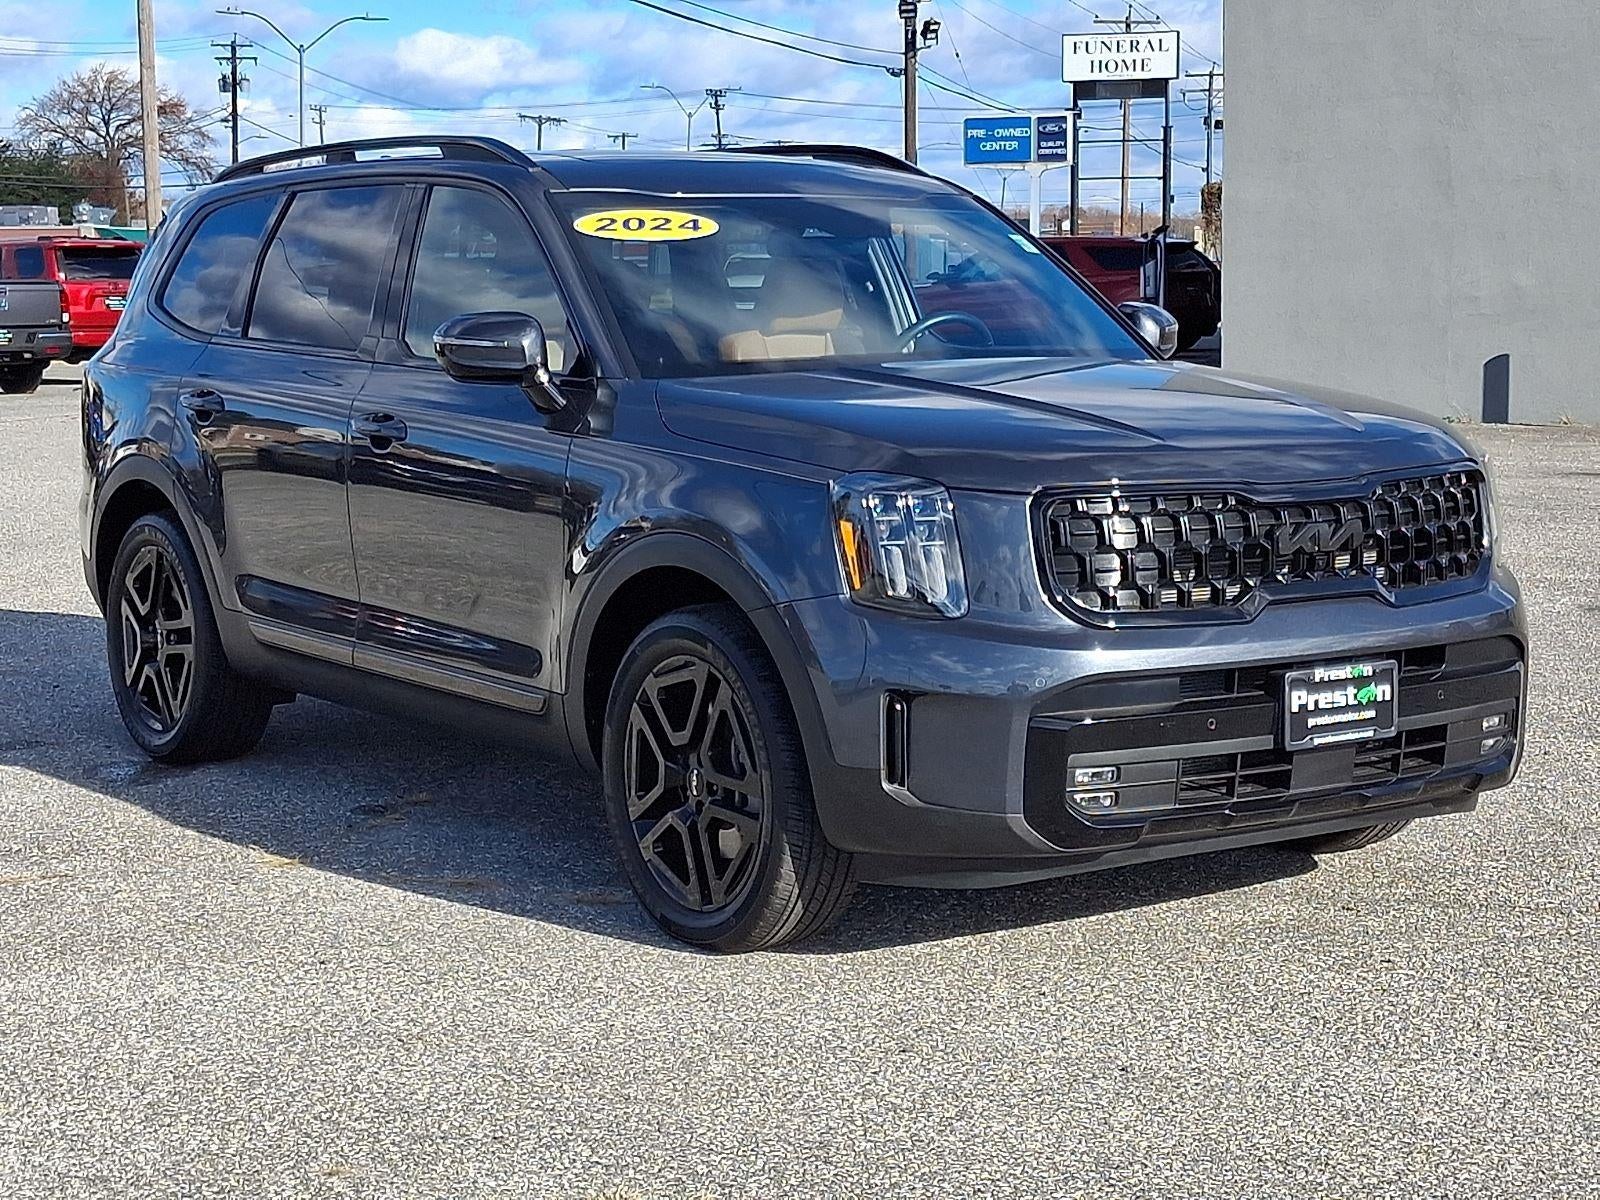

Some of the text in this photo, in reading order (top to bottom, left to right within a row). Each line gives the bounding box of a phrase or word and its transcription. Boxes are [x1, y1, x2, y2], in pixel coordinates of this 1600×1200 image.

[1073, 38, 1169, 55] FUNERAL
[1090, 57, 1152, 74] HOME
[980, 141, 1019, 151] CENTER
[594, 217, 702, 232] 2024
[1290, 681, 1392, 713] Preston
